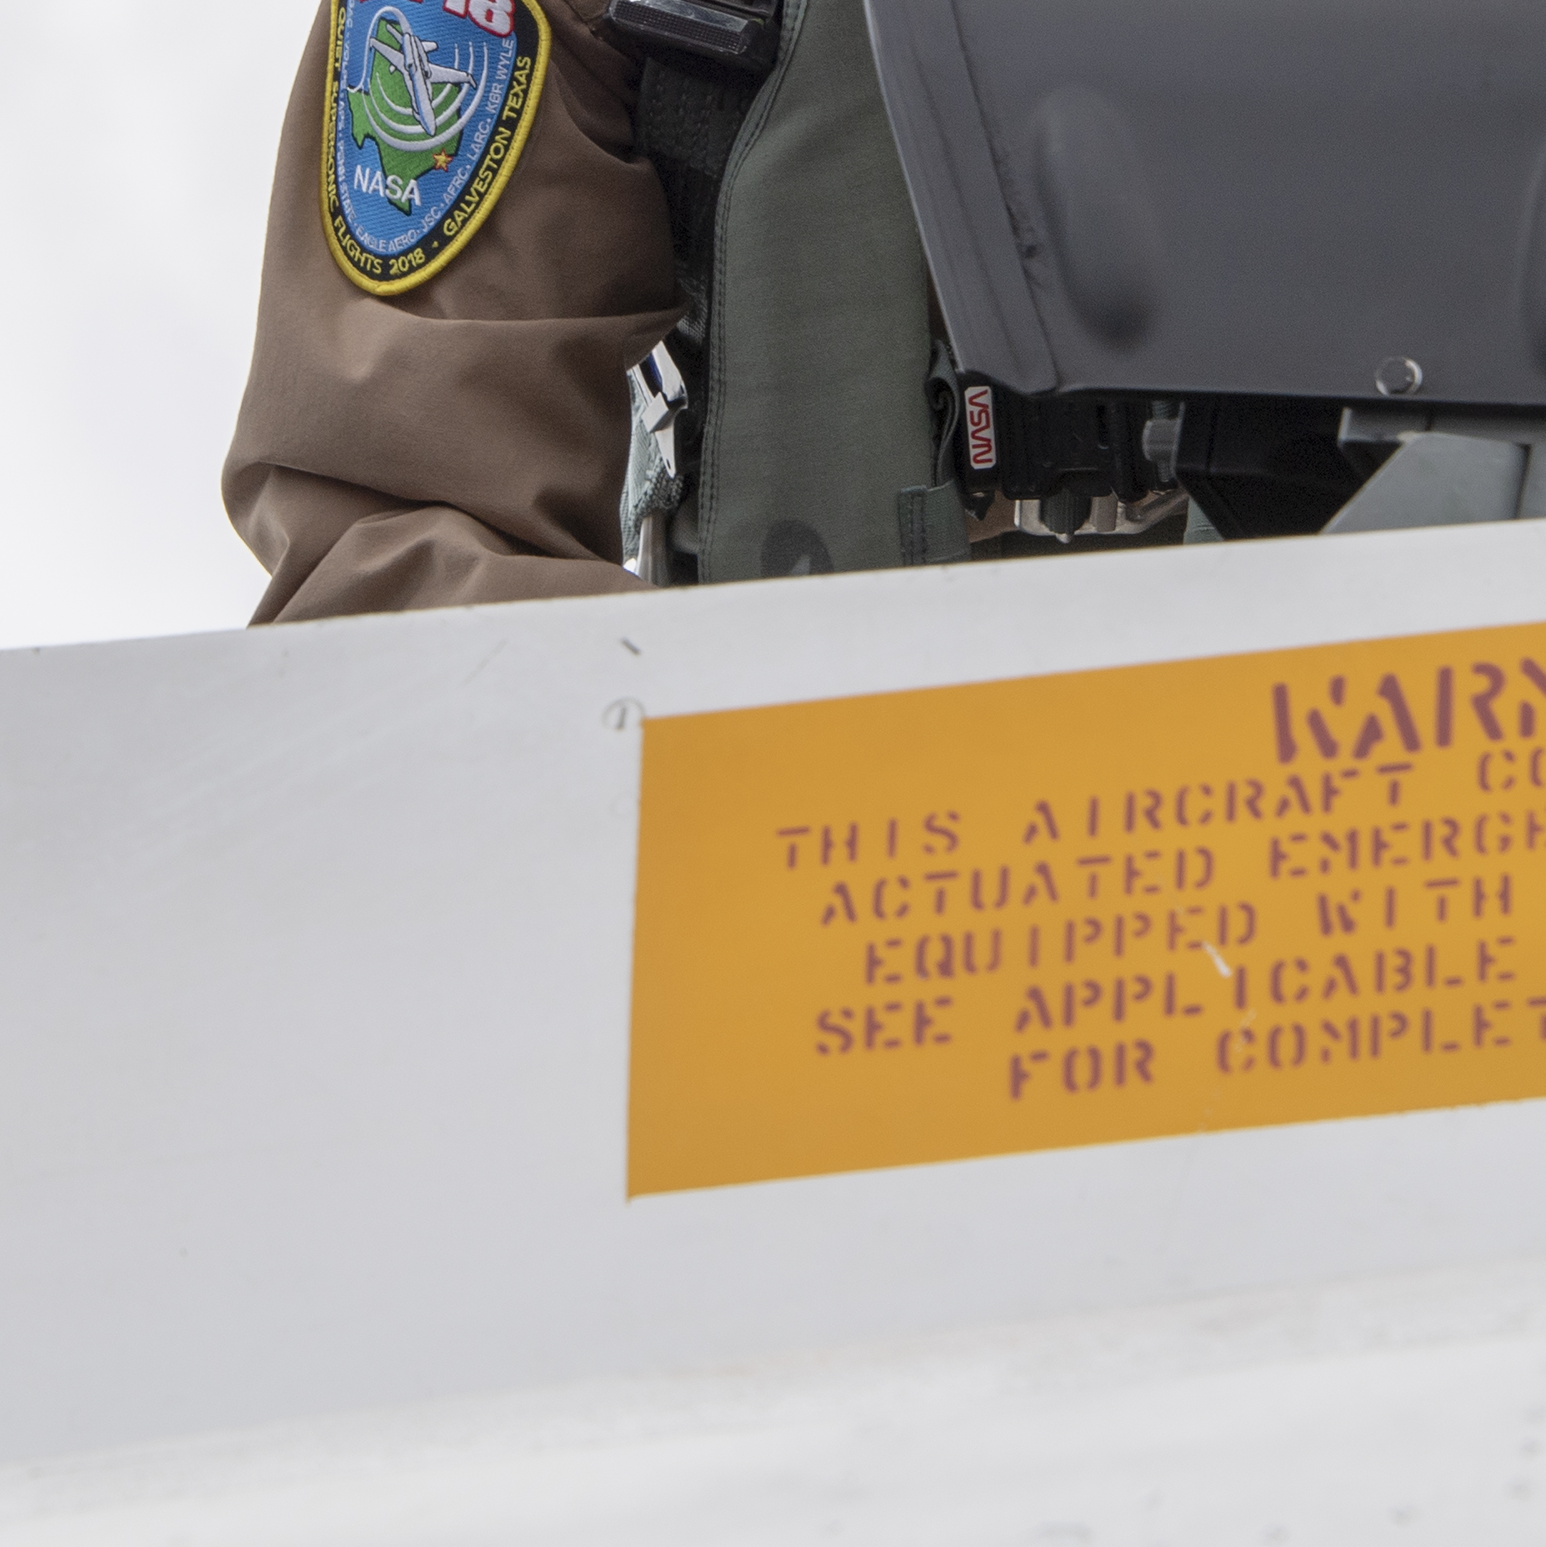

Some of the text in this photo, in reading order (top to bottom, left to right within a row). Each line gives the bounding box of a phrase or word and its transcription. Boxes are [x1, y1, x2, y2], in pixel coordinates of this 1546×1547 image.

[326, 7, 532, 276] QUIET SUPERSONIC FLIGHTS 2018 GALVESTON TEXAS
[340, 182, 357, 223] STATE
[355, 224, 387, 252] EAGLE
[485, 84, 505, 114] KBR
[495, 39, 515, 82] WYLE
[354, 164, 422, 206] NASA
[778, 811, 959, 869] THIS
[1024, 762, 1413, 844] AIRCRAFT
[822, 847, 1214, 925] ACTUATED
[865, 902, 1256, 985] EQUIPPED
[1317, 874, 1511, 936] WITH
[816, 996, 952, 1055] SEE
[1015, 937, 1513, 1033] APPLICABLE
[1010, 1039, 1154, 1100] FOR
